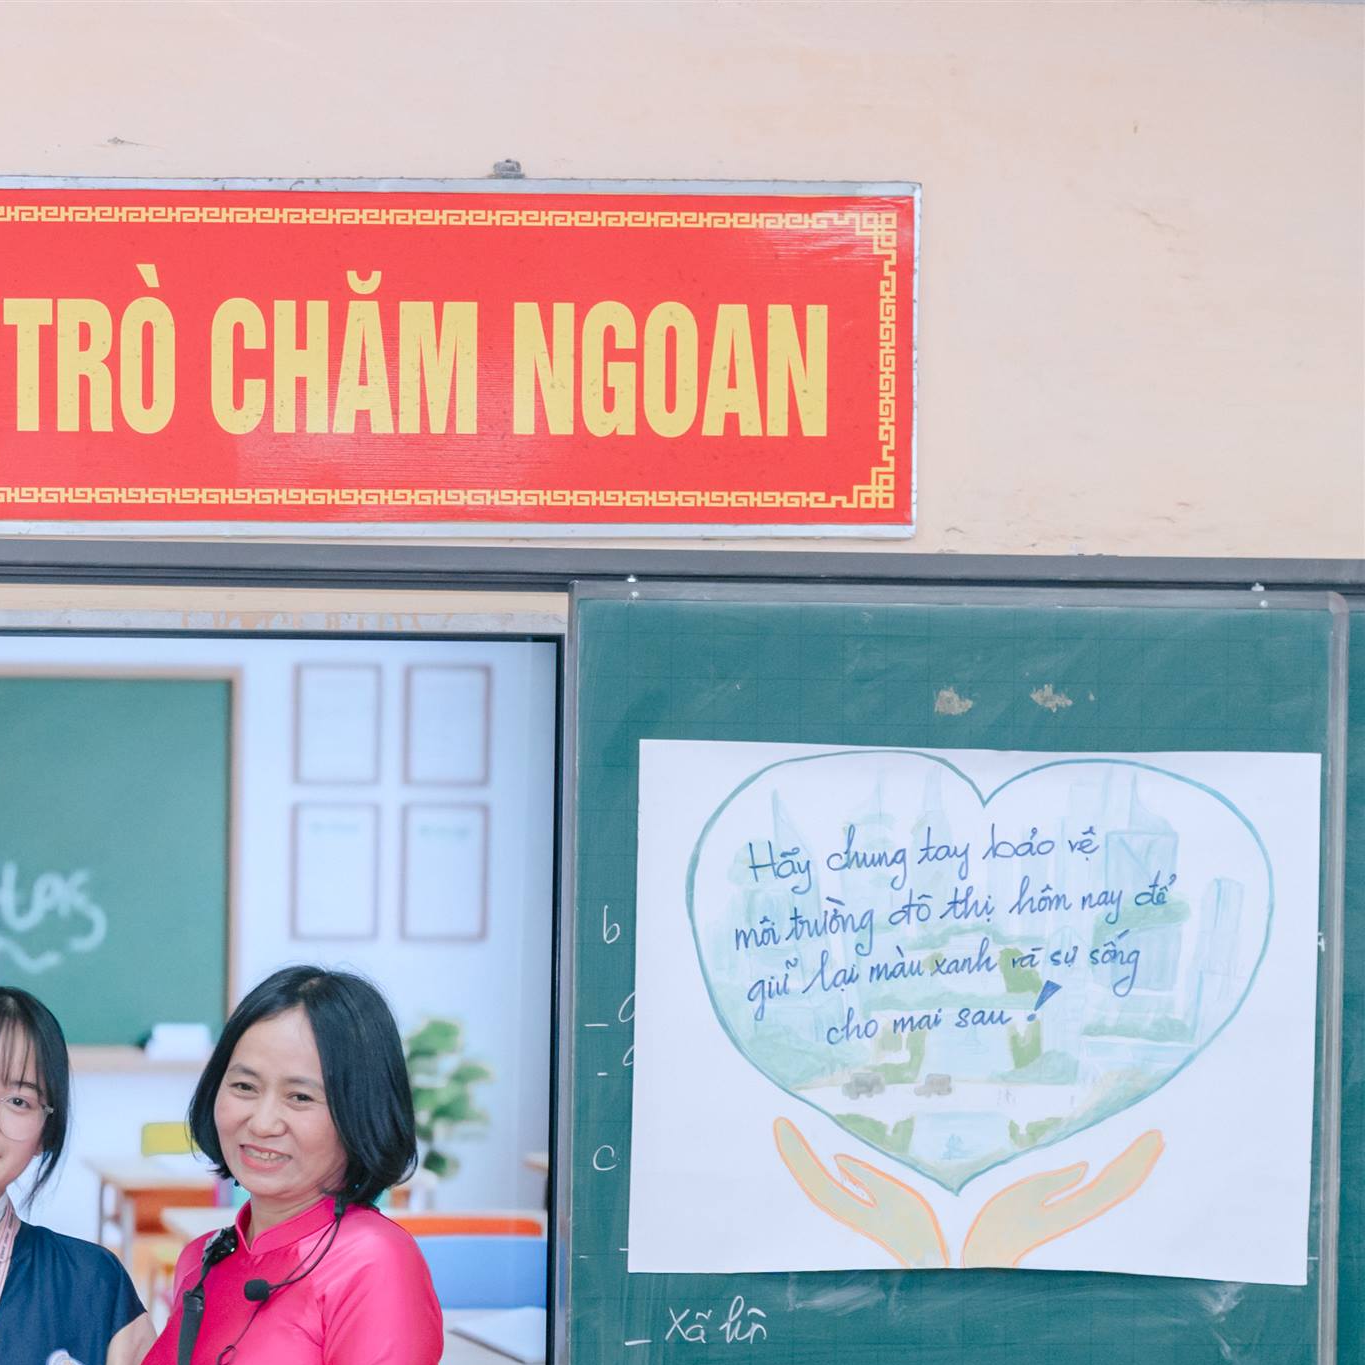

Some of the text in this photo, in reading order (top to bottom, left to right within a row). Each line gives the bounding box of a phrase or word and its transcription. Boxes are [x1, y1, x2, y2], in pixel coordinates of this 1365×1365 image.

[2, 264, 176, 435] TRÒ
[210, 270, 478, 436] CHĂM
[512, 300, 830, 438] NGOAN
[749, 823, 1100, 895] Hãy chung tay bảo vệ
[602, 905, 621, 944] b
[735, 916, 781, 950] môi
[888, 888, 933, 925] đô
[939, 886, 995, 922] thị
[1009, 875, 1072, 915] hôm
[1081, 889, 1123, 925] nay
[1134, 870, 1177, 907] để
[747, 957, 799, 1022] giữ
[802, 950, 859, 992] lại
[869, 945, 924, 983] màu
[931, 937, 998, 977] xanh
[1050, 945, 1079, 968] sự
[1089, 929, 1141, 998] sống
[826, 1006, 880, 1045] cho
[892, 1008, 943, 1034] mai
[954, 1007, 1012, 1028] sau
